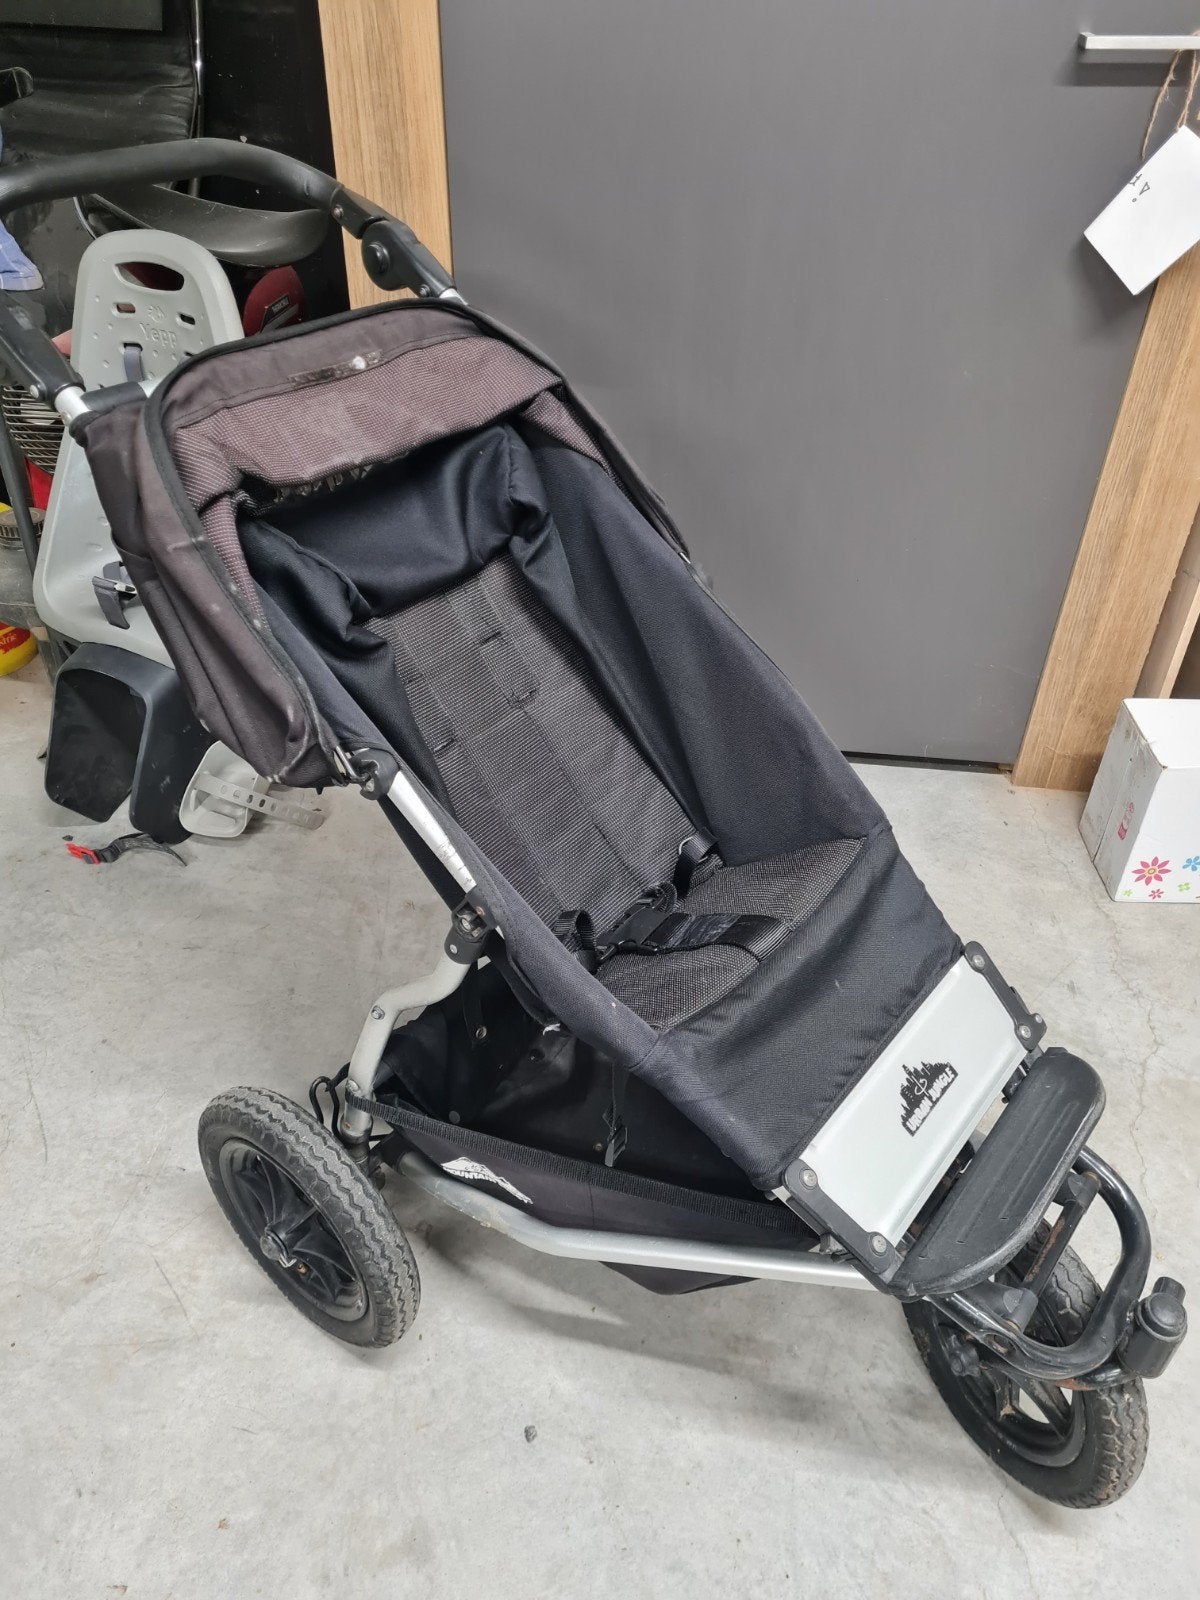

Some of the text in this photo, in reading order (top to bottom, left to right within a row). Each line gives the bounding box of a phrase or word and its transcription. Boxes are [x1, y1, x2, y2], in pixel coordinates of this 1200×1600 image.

[139, 322, 177, 349] Yepp
[905, 1066, 955, 1132] URBAN JUNGLE
